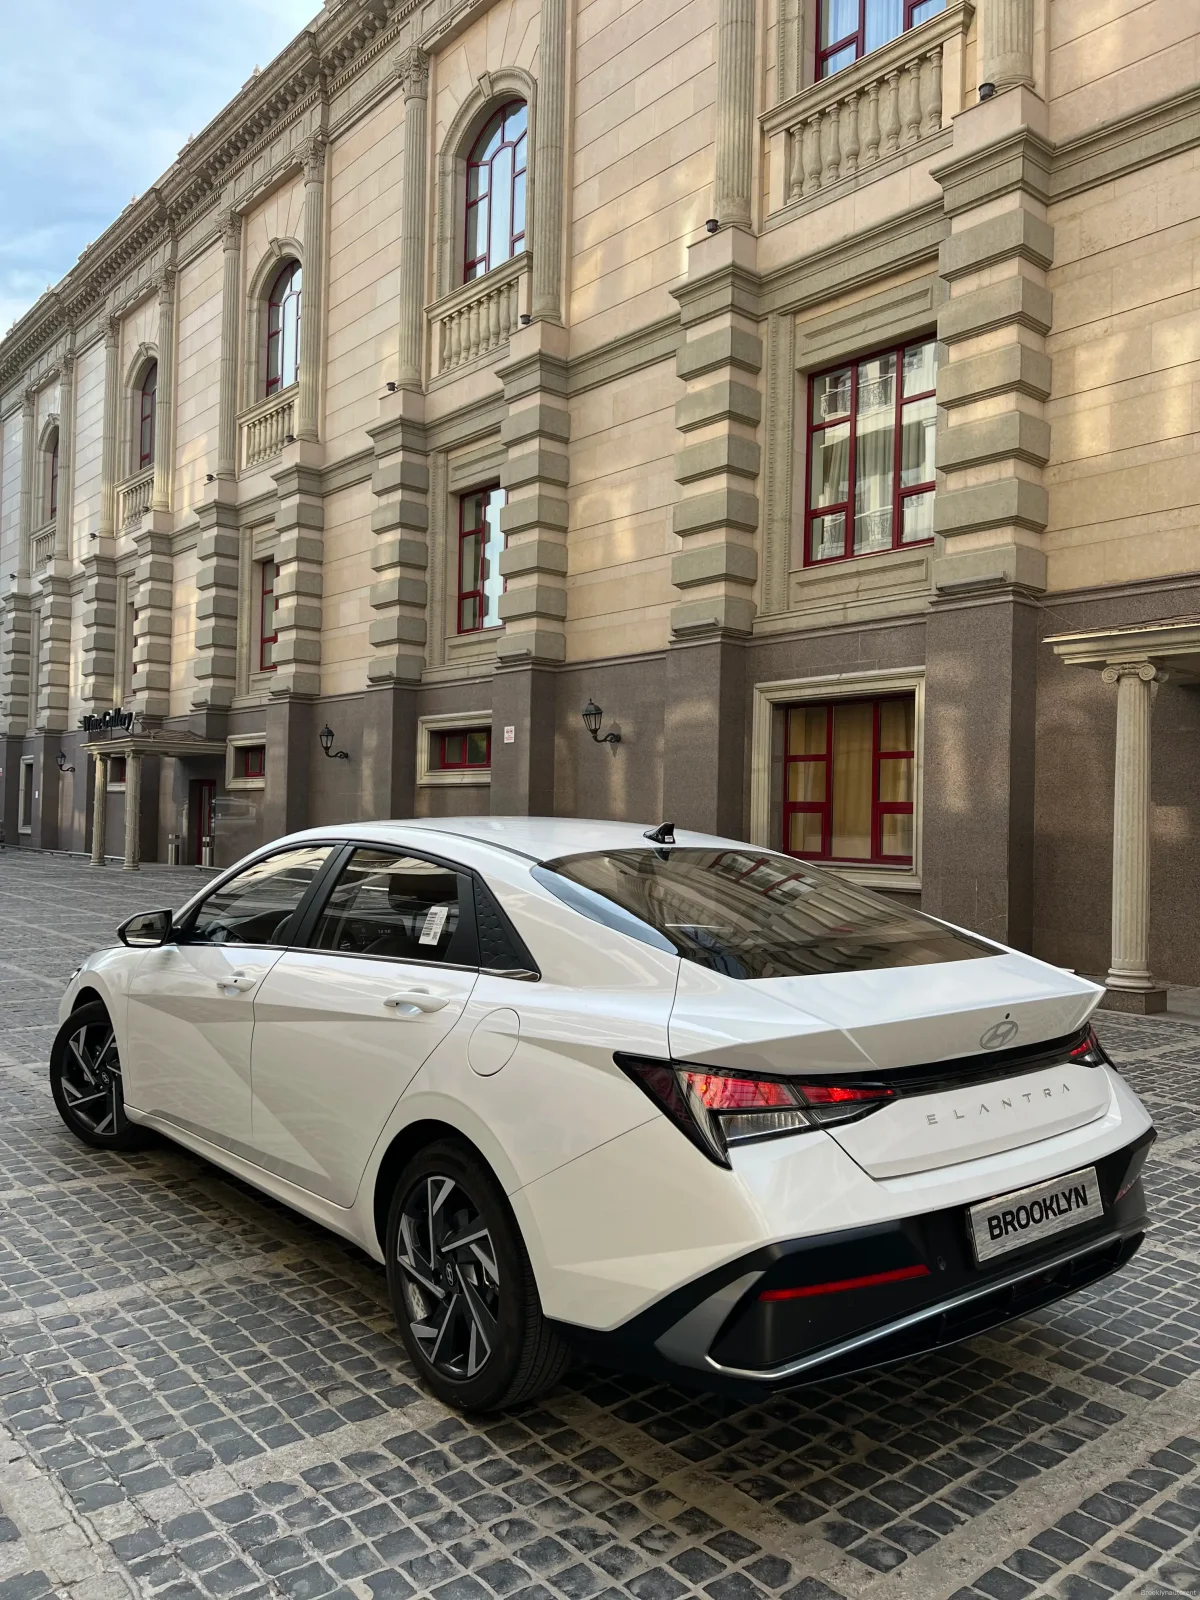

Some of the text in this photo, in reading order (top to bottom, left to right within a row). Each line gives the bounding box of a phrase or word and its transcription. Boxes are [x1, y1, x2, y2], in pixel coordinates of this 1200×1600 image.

[83, 708, 134, 731] Wine Gallery
[925, 1083, 1071, 1125] ELANTRA
[987, 1184, 1088, 1240] BROOKLYN
